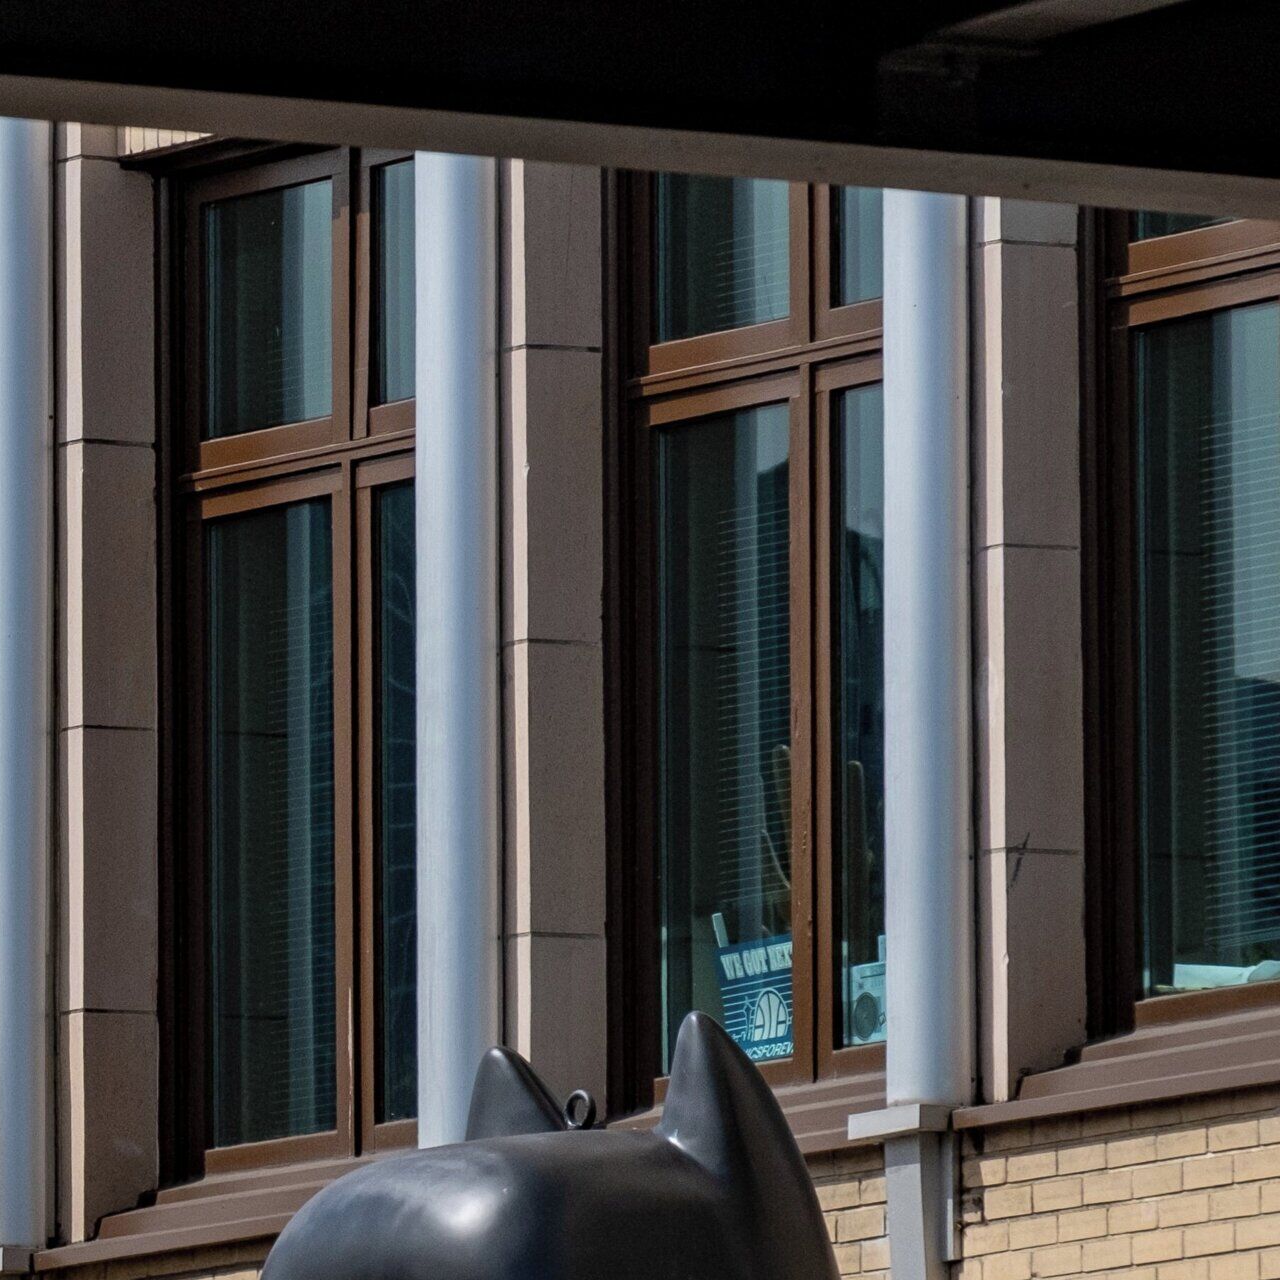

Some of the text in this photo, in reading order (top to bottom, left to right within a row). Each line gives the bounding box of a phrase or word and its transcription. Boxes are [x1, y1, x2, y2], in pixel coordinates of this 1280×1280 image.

[720, 941, 793, 981] WE GOT NEX
